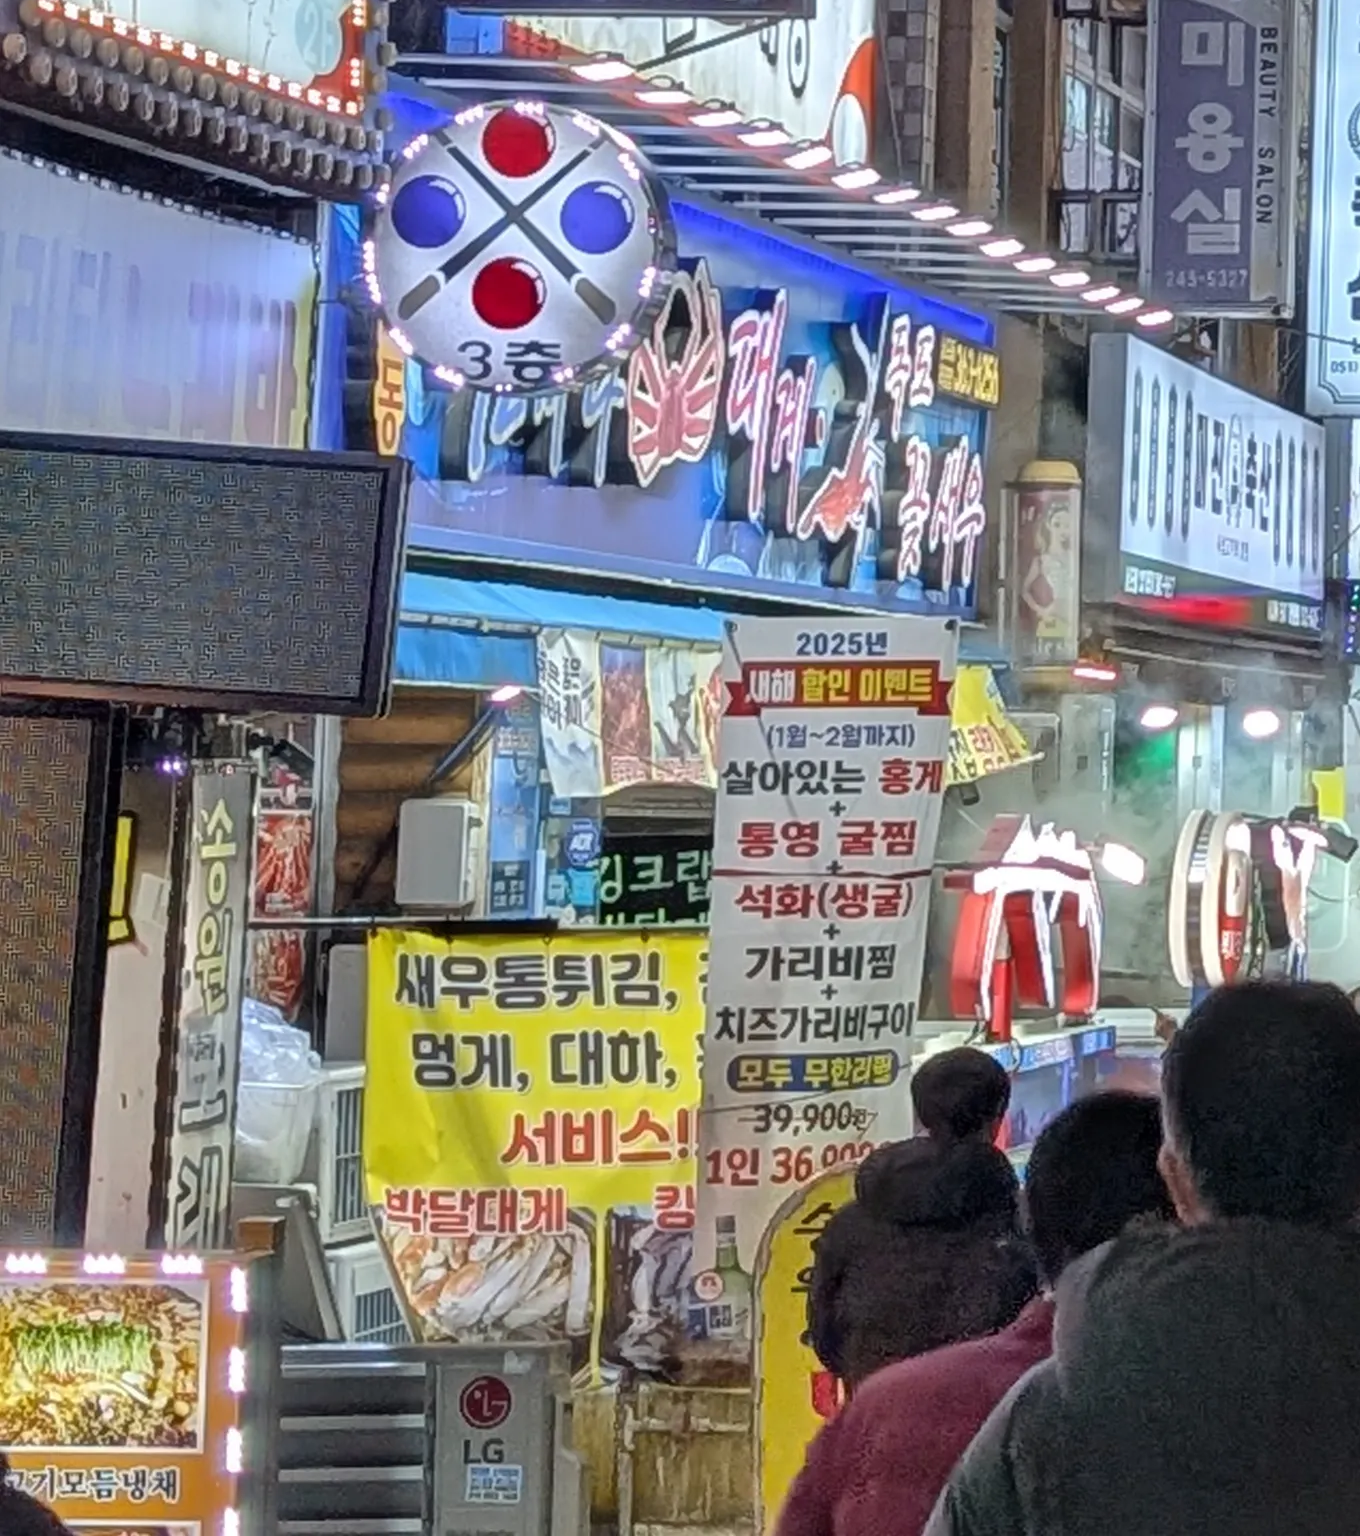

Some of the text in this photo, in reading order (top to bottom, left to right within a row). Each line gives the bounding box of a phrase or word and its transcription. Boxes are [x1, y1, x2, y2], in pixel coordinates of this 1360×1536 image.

[1256, 27, 1278, 225] BEAUTY SALON
[457, 340, 562, 383] 3층
[796, 632, 888, 657] 2025년
[747, 667, 933, 704] 새해 할인 이벤트
[765, 721, 916, 751] (1월~2월까지)
[722, 760, 866, 796] 살아있는
[877, 758, 944, 796] 홍게
[737, 820, 918, 858] 통영 굴찜
[734, 883, 913, 920] 석화(생굴)
[396, 952, 680, 1014] 새우통튀김,
[745, 945, 897, 984] 가리비찜
[714, 1003, 914, 1046] 치즈가리비구이
[412, 1031, 679, 1094] 멍게, 대하,
[737, 1052, 896, 1089] 모두 무한리필
[706, 1148, 759, 1186] 1인
[384, 1187, 567, 1237] 박달대게
[463, 1438, 505, 1464] LG
